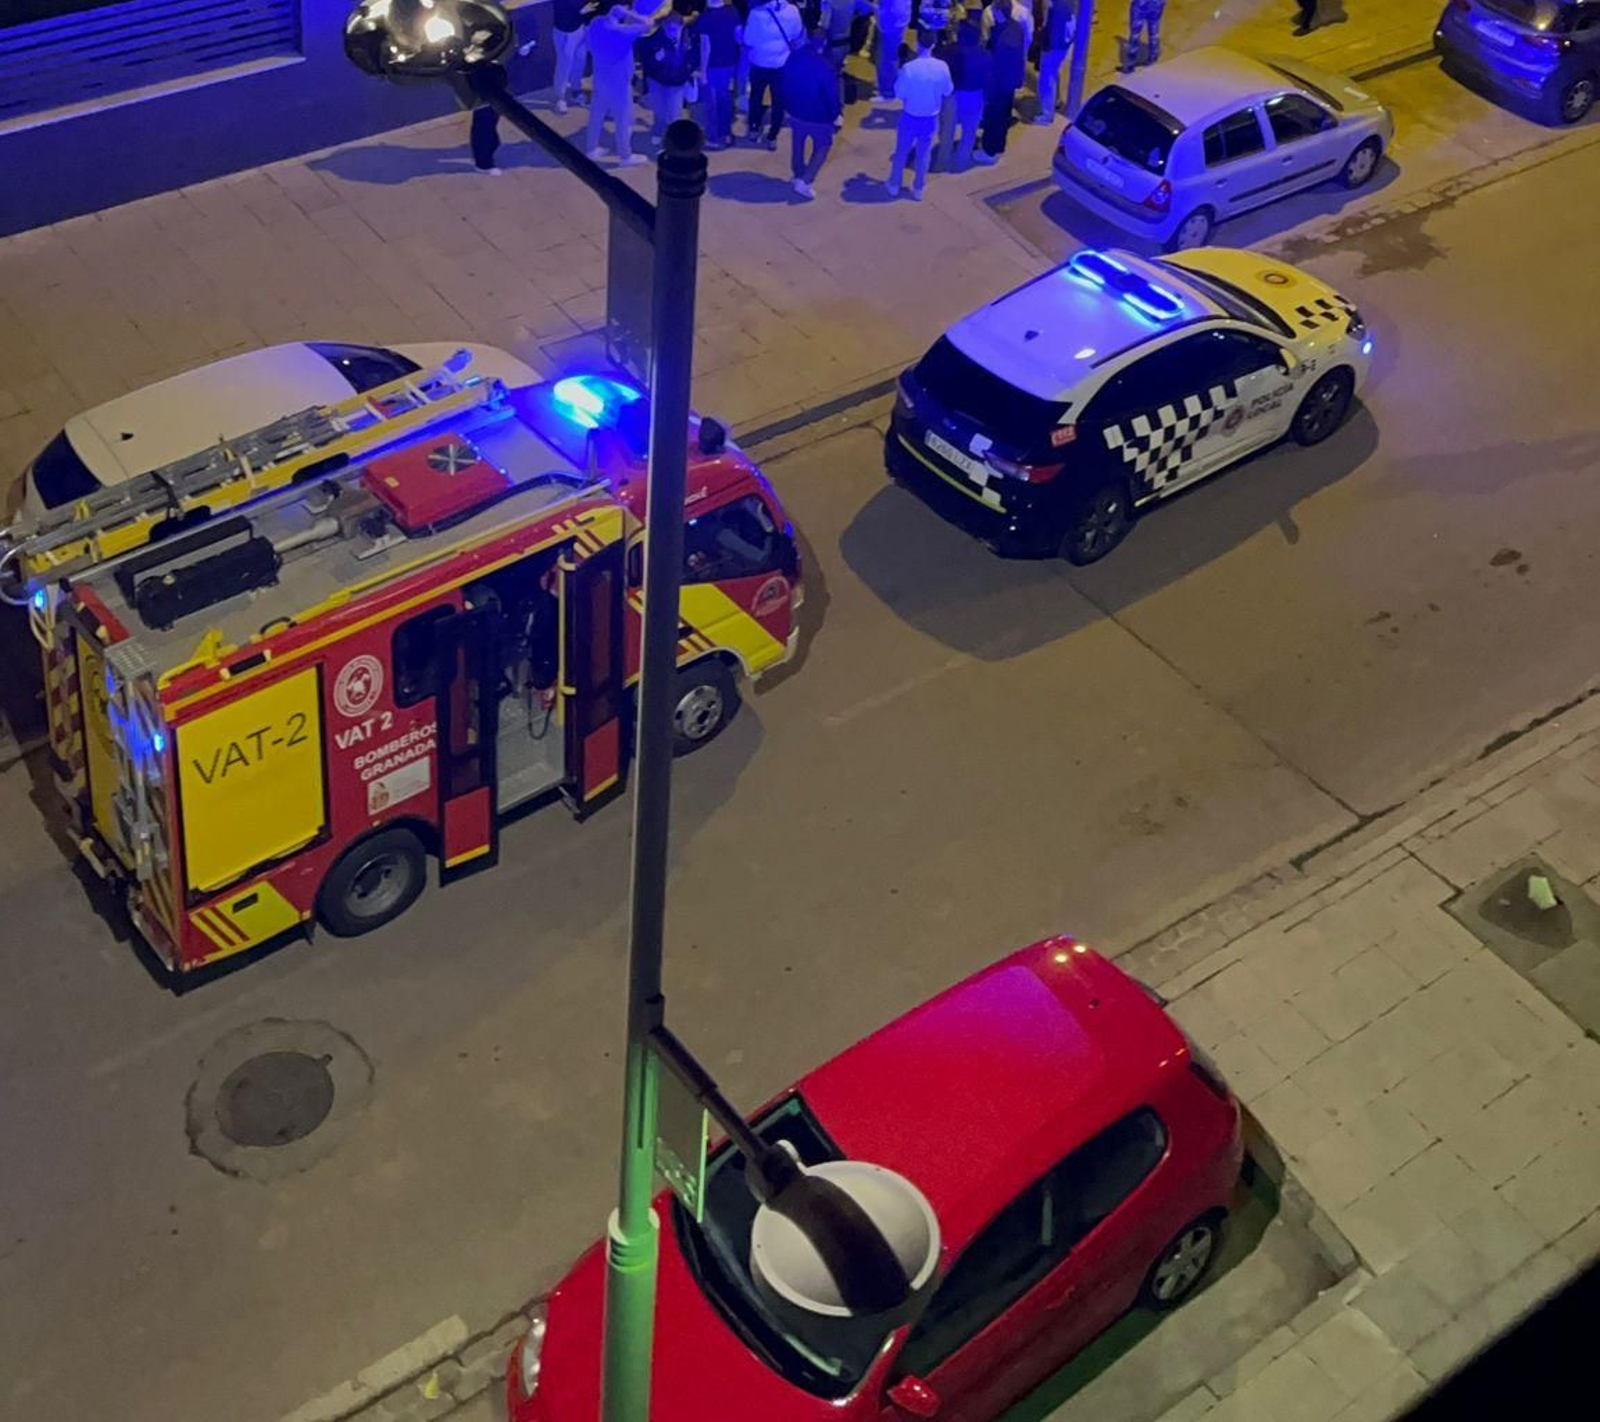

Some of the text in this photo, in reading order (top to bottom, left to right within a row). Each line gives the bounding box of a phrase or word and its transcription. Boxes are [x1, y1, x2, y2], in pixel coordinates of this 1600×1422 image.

[192, 712, 308, 784] VAT-2
[334, 711, 394, 750] VAT 2
[360, 738, 437, 781] GRANADA
